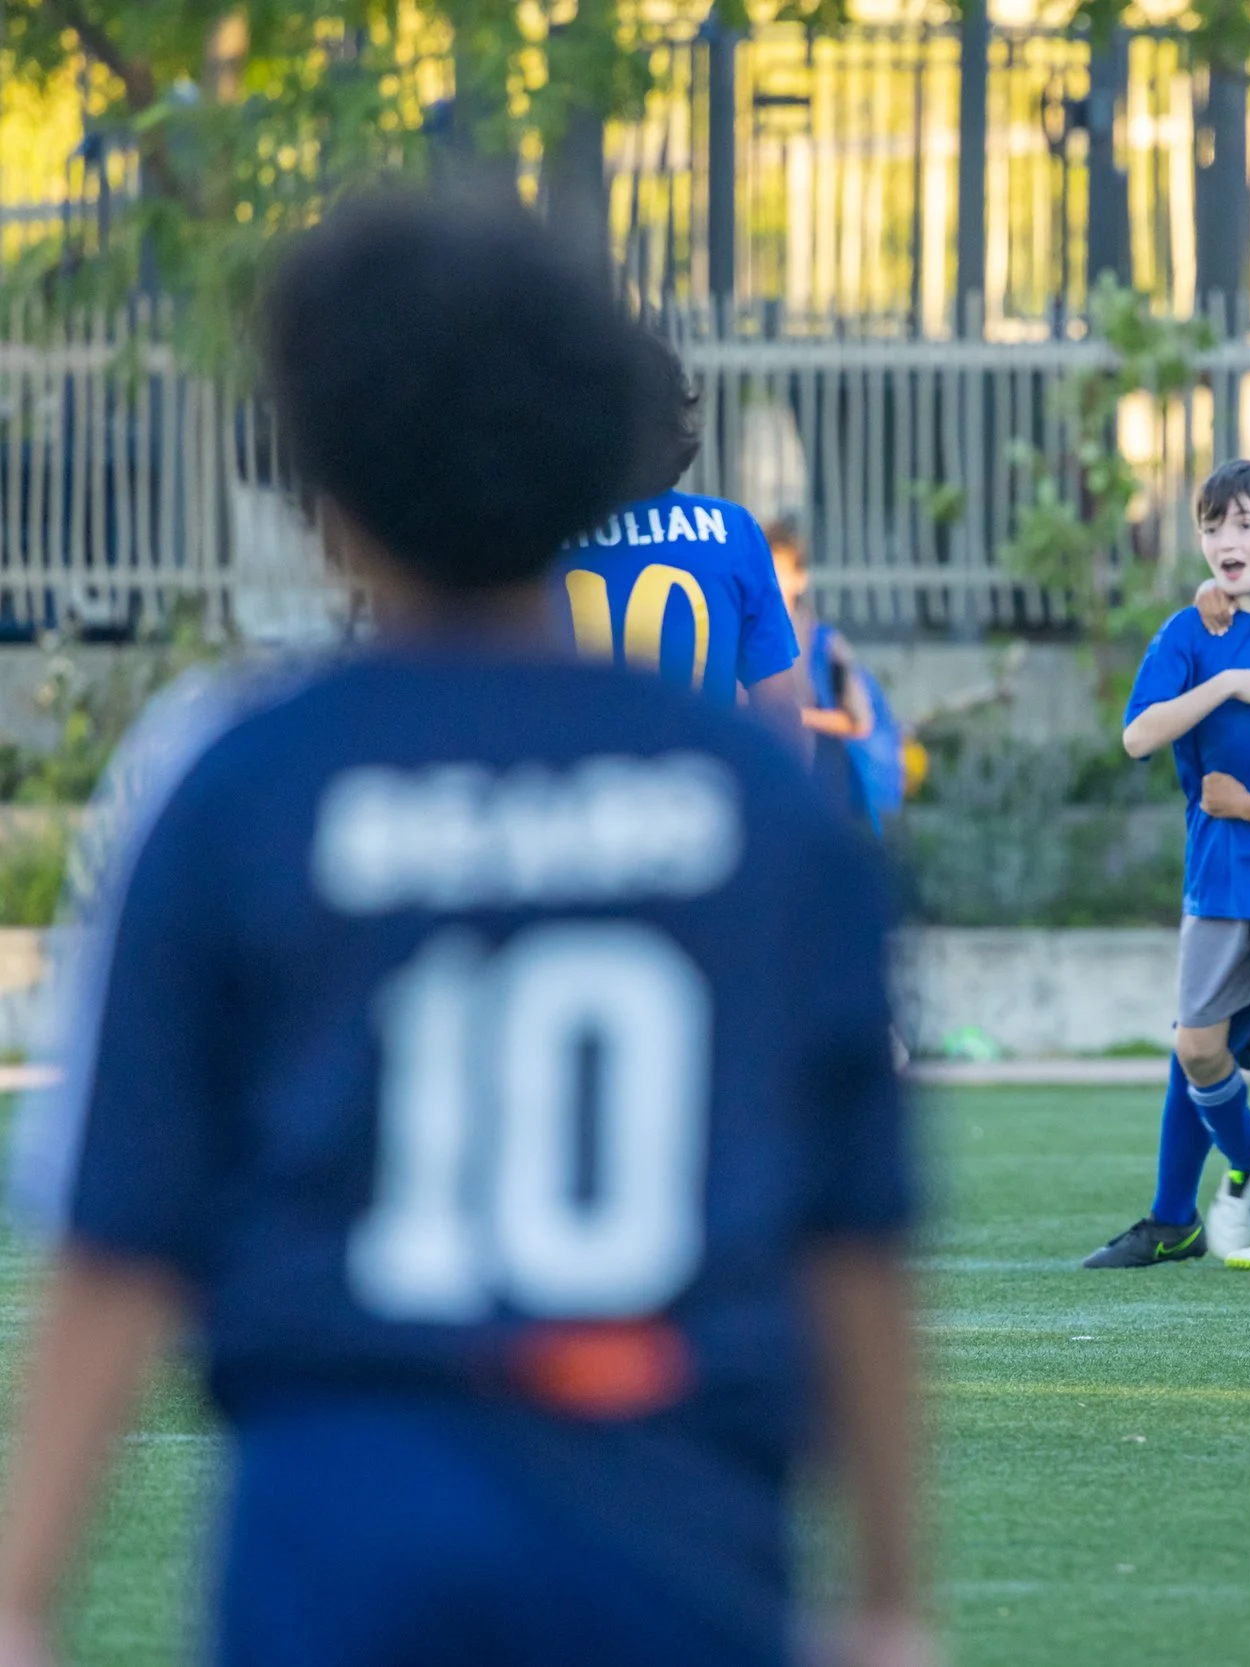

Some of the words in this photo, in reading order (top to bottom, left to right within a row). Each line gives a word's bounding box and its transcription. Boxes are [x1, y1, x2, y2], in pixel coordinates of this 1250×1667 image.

[562, 506, 727, 549] ULIAN
[565, 563, 709, 692] 10
[350, 920, 712, 1324] 10
